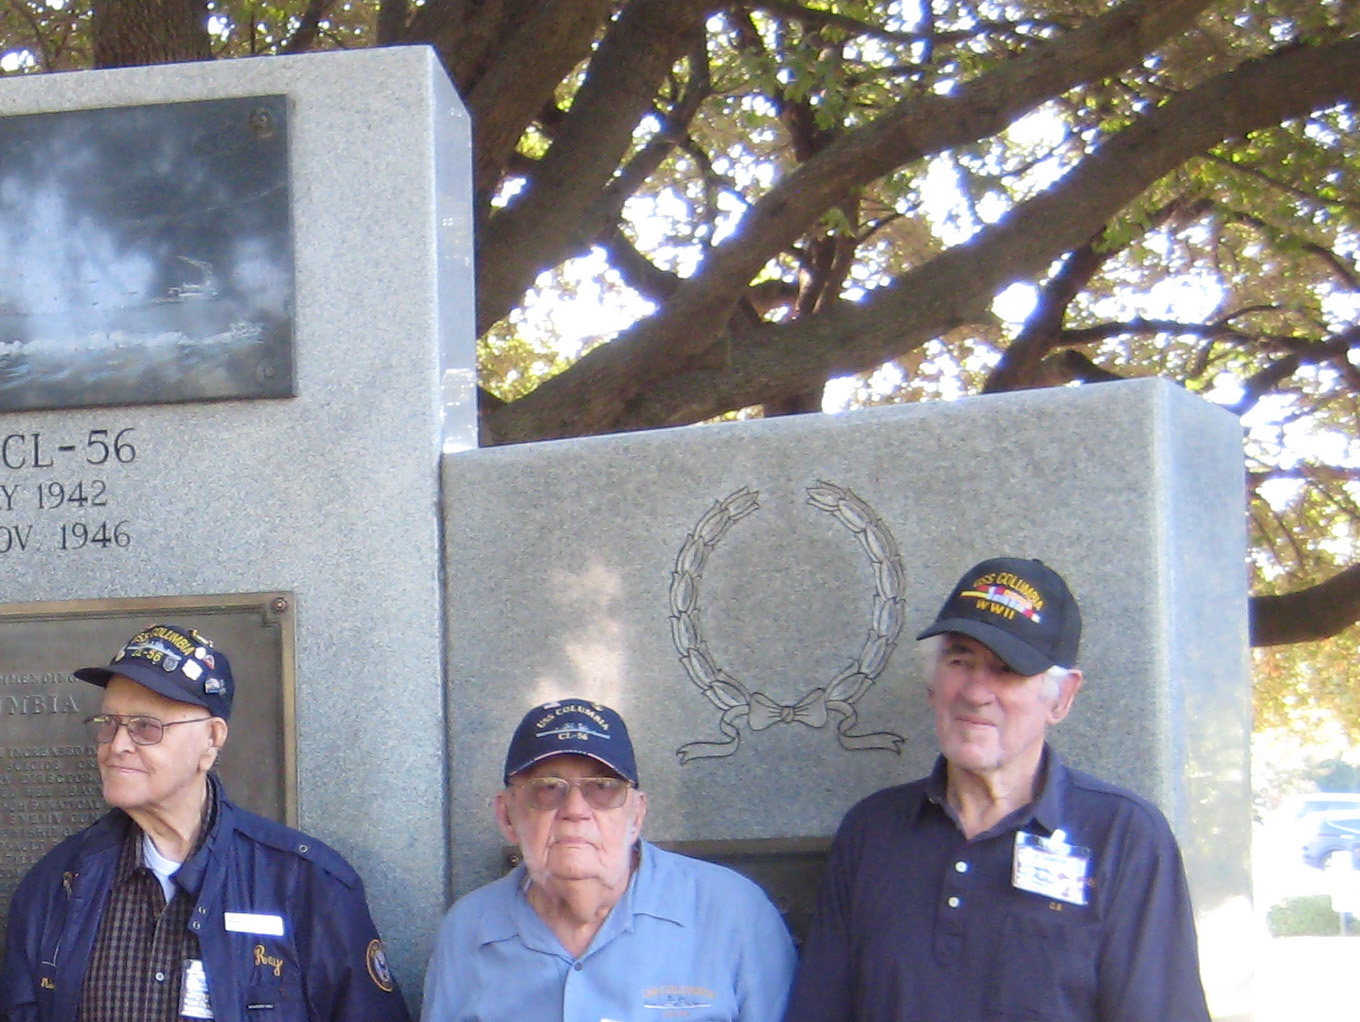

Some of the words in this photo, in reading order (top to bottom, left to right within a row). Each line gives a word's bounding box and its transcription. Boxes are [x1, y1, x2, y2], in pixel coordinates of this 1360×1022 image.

[1, 428, 137, 469] CL-56
[37, 480, 108, 509] 1942
[57, 519, 131, 549] 1946
[995, 572, 1044, 611] COLUMBIA
[555, 705, 610, 731] COLUMBIA
[253, 944, 284, 977] Ray
